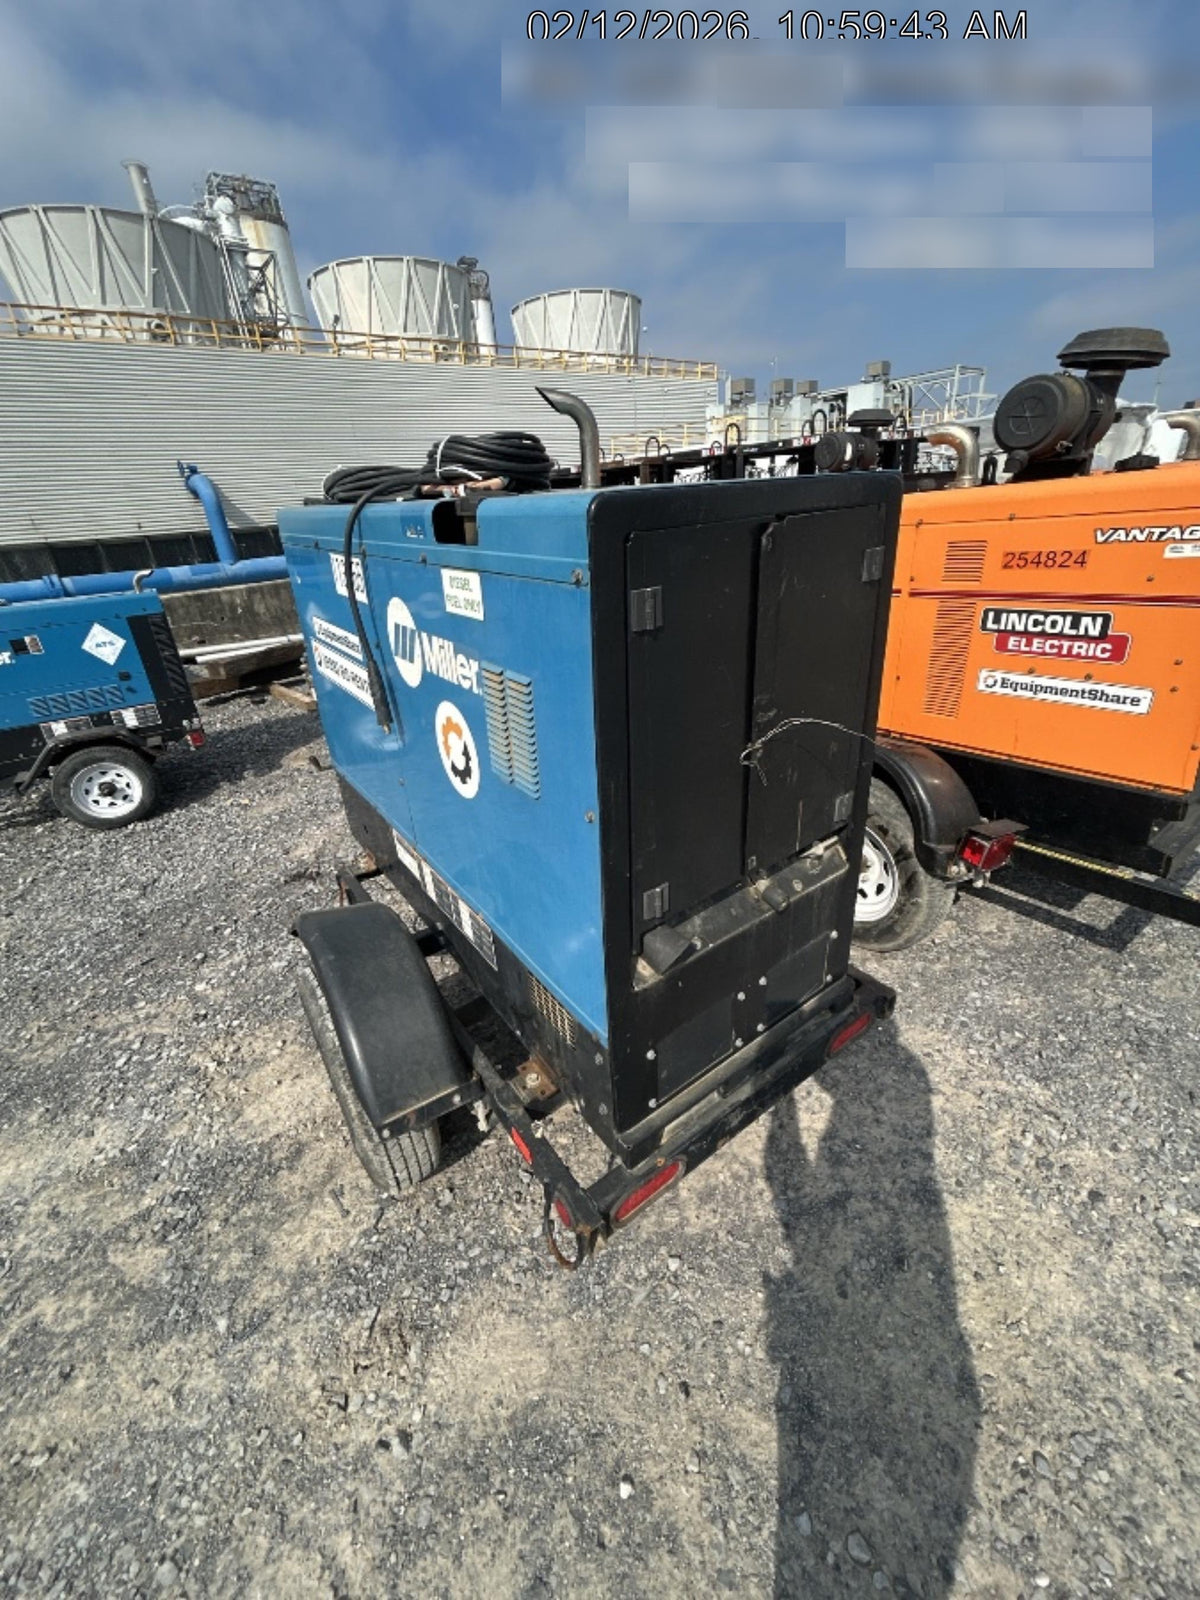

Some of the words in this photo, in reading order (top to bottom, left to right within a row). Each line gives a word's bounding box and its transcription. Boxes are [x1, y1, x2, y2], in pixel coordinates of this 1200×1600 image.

[1002, 550, 1088, 569] 254824
[986, 610, 1104, 637] LINCOLN
[1007, 636, 1112, 659] ELECTRIC
[420, 630, 480, 694] Miller
[1000, 676, 1142, 707] EquipmentShare
